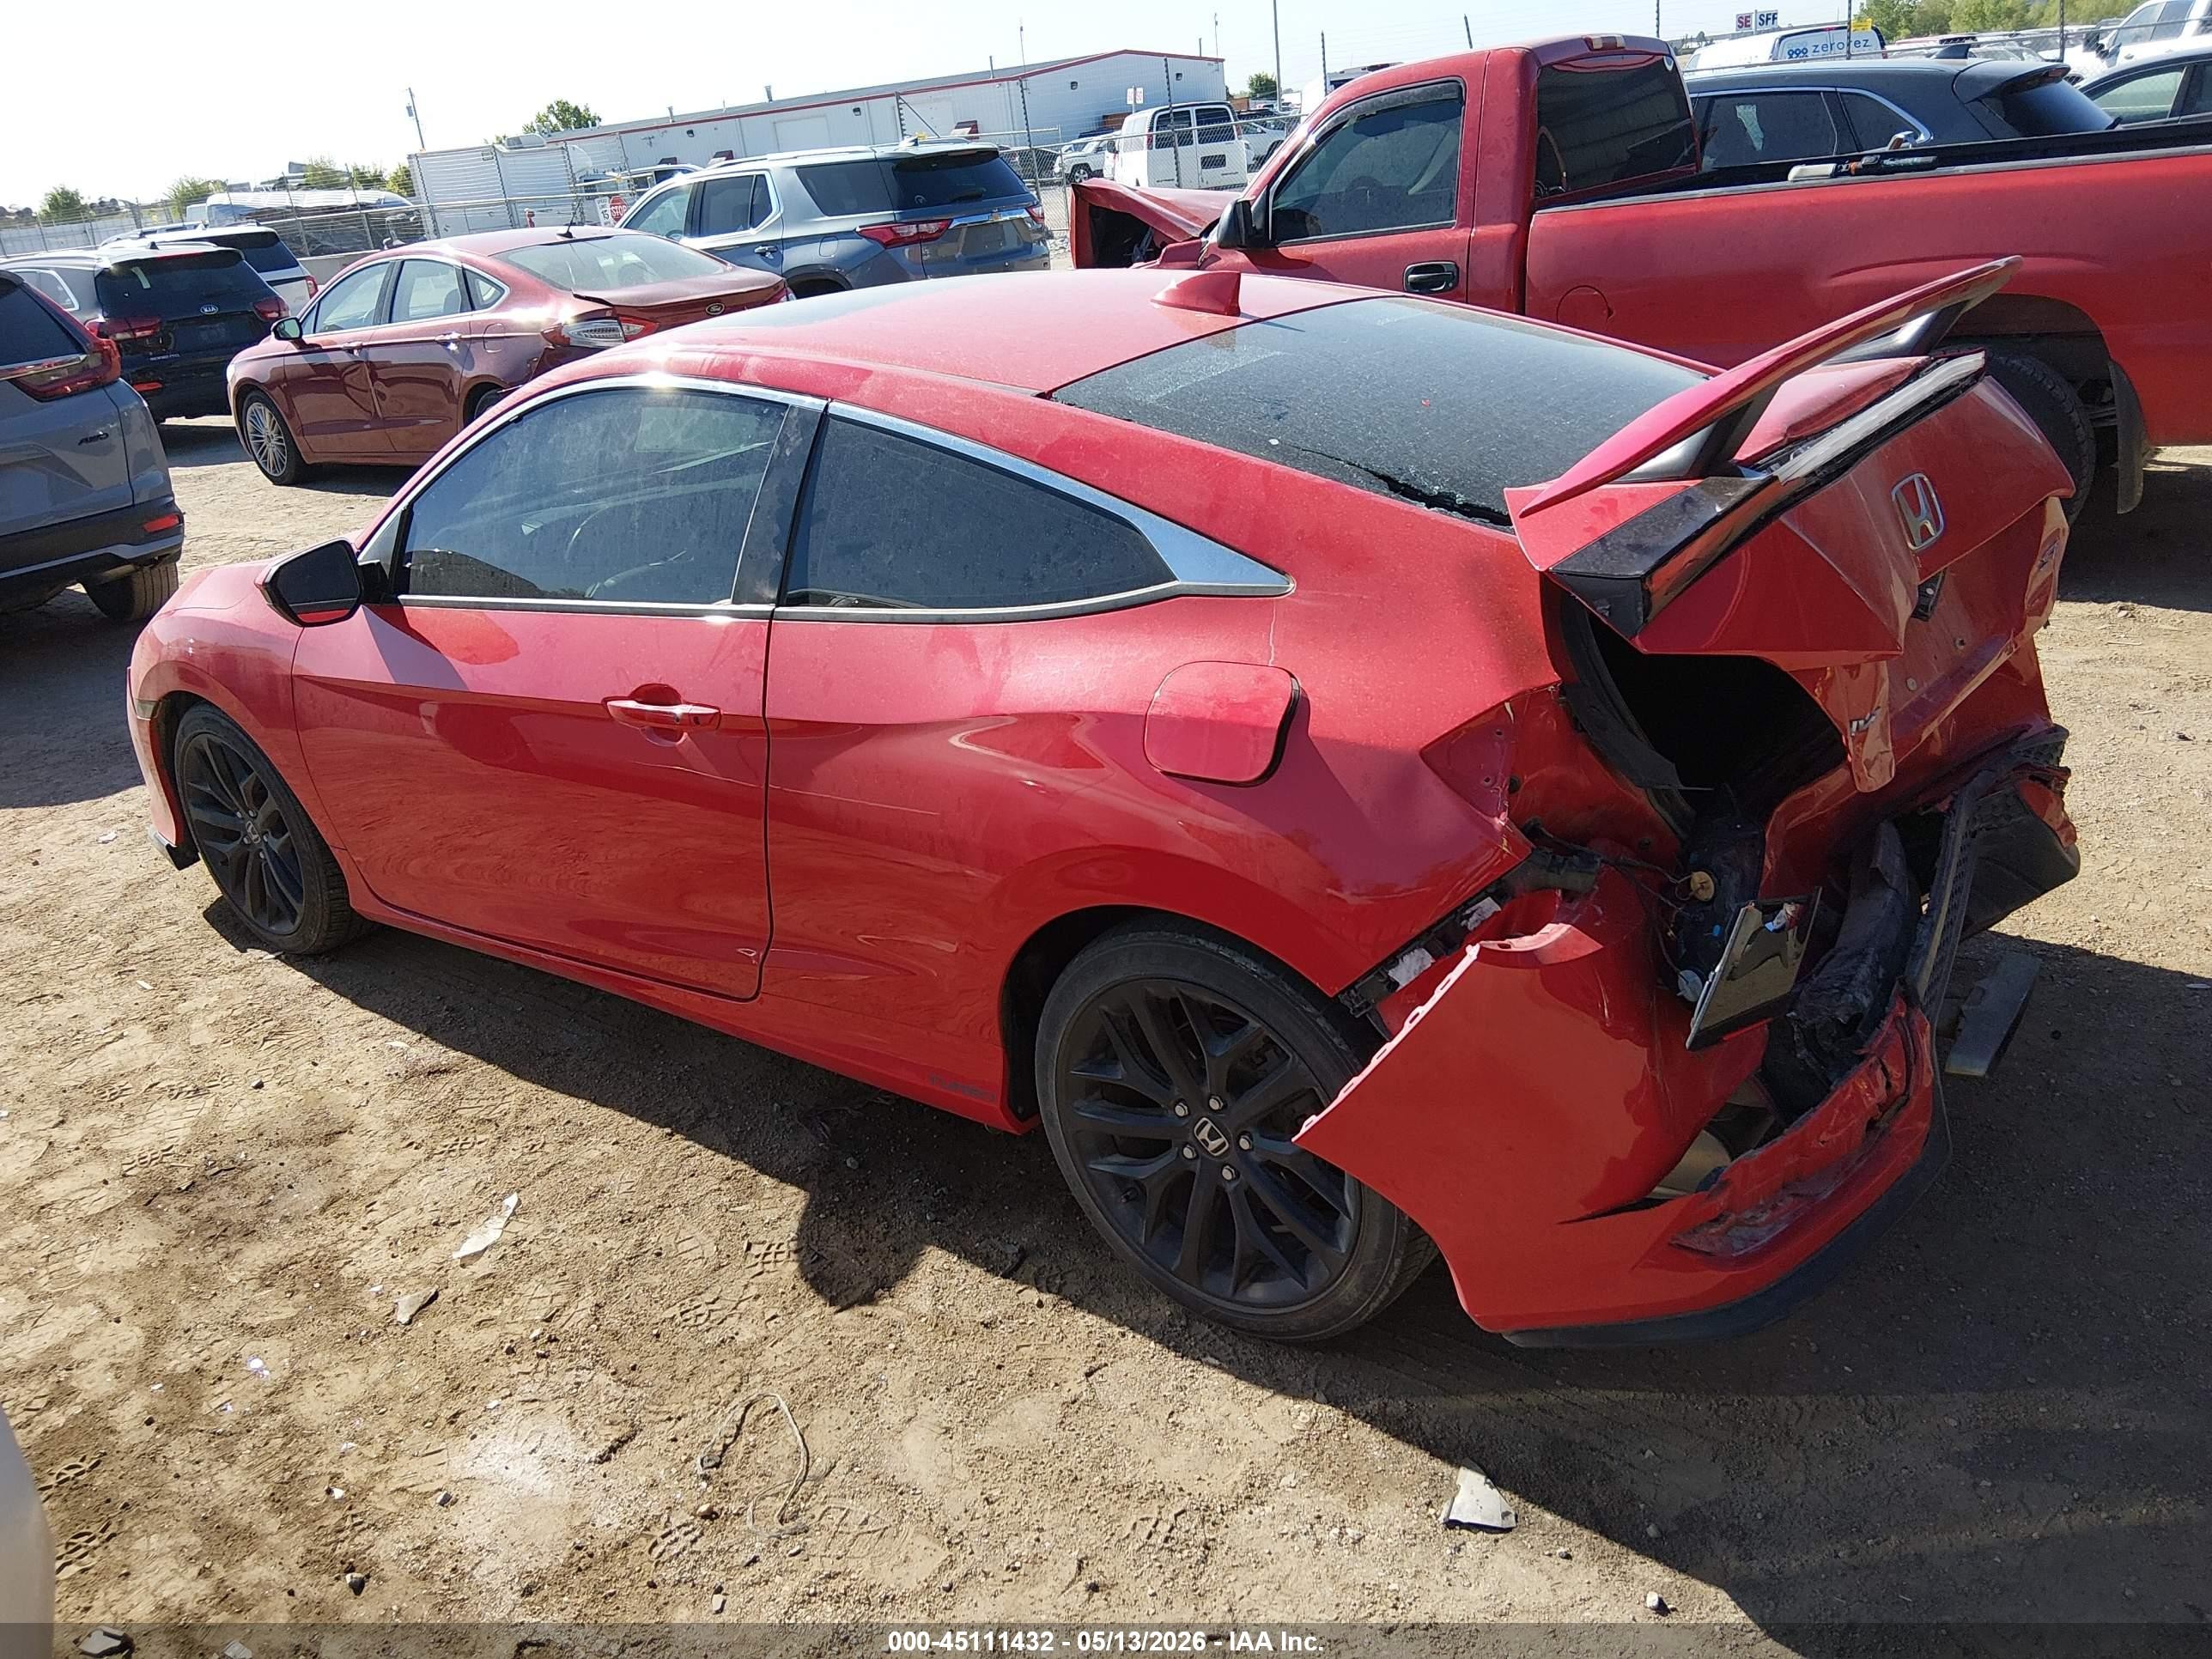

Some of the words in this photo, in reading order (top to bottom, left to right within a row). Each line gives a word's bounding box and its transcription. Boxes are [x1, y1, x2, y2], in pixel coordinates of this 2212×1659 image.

[1737, 15, 1751, 28] SE
[1758, 12, 1778, 27] SFF
[611, 204, 627, 216] STOP
